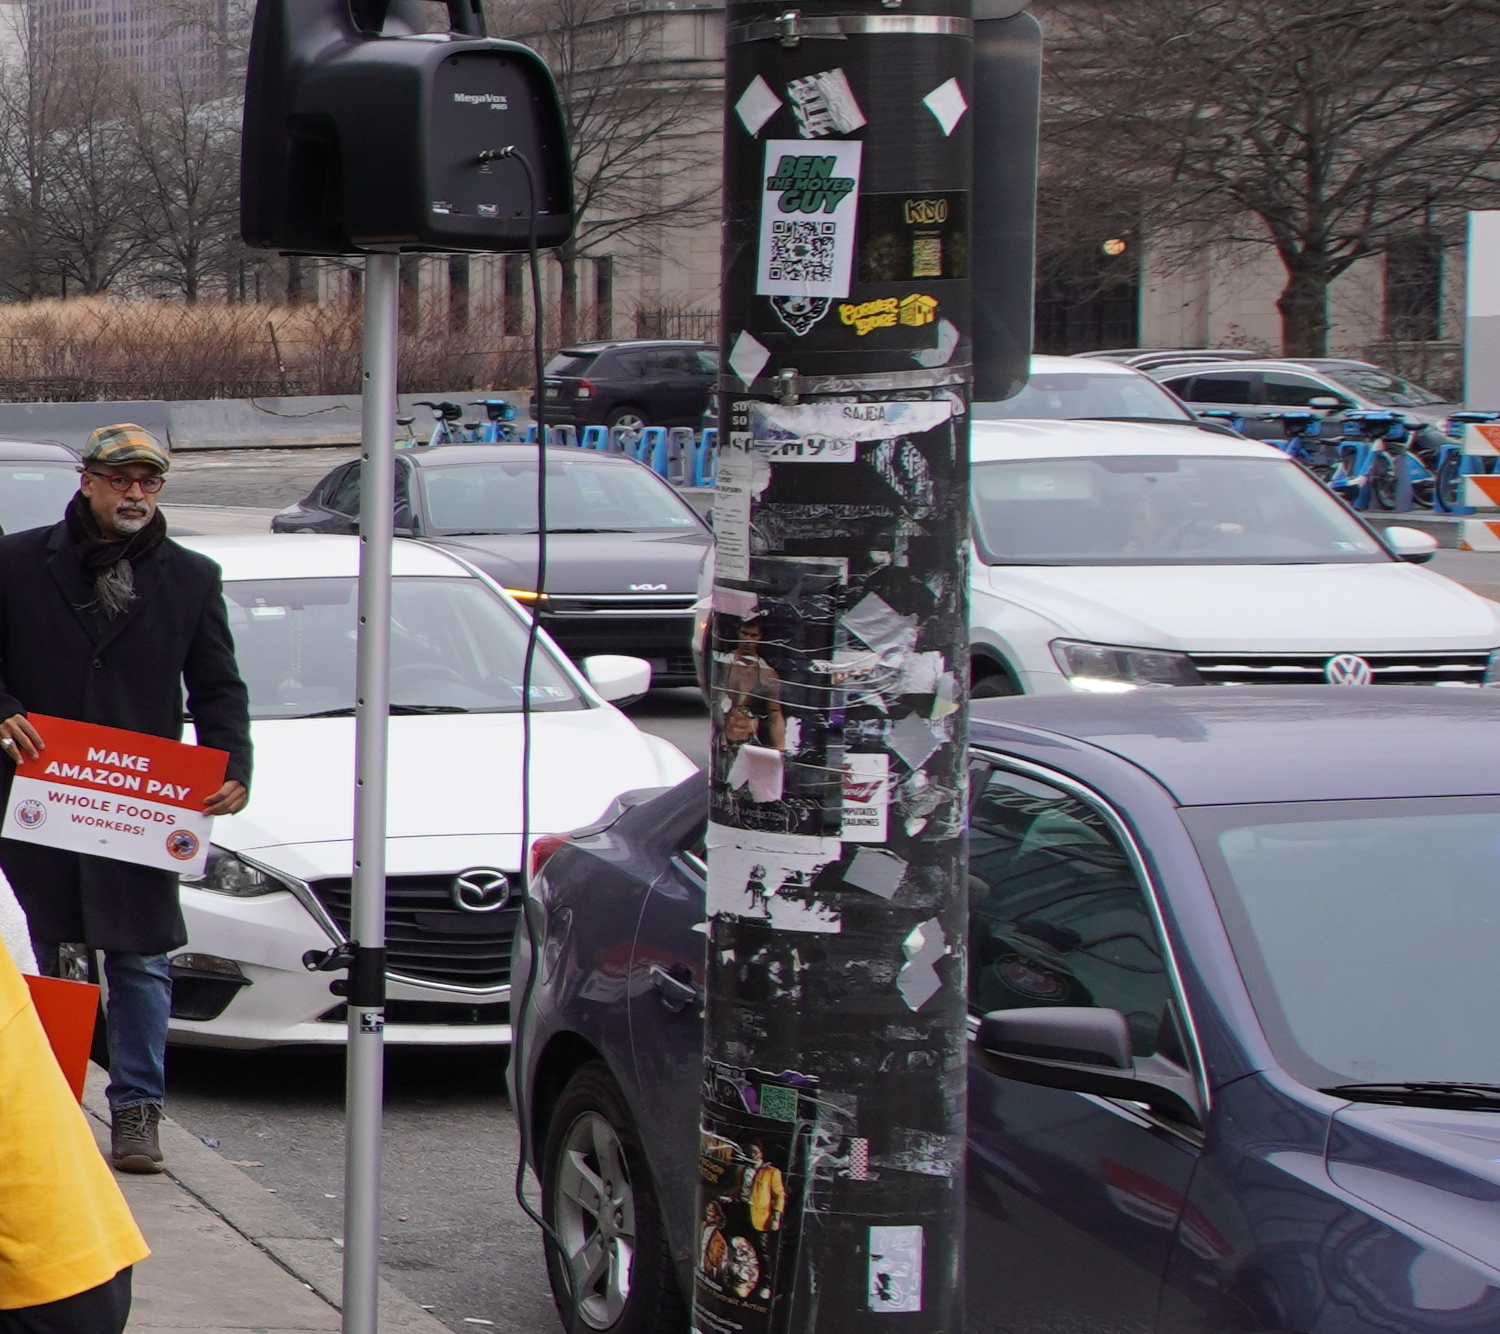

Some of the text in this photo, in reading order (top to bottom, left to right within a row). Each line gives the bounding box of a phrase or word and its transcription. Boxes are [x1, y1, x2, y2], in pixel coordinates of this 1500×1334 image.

[454, 93, 507, 104] MegaVox
[774, 155, 838, 179] BEN
[766, 177, 855, 192] THE MOVER
[778, 190, 850, 214] GUY
[86, 747, 151, 772] MAKE
[44, 761, 192, 802] AMAZON PAY
[47, 790, 177, 826] WHOLE FOODS
[71, 813, 146, 837] WORKERS!
